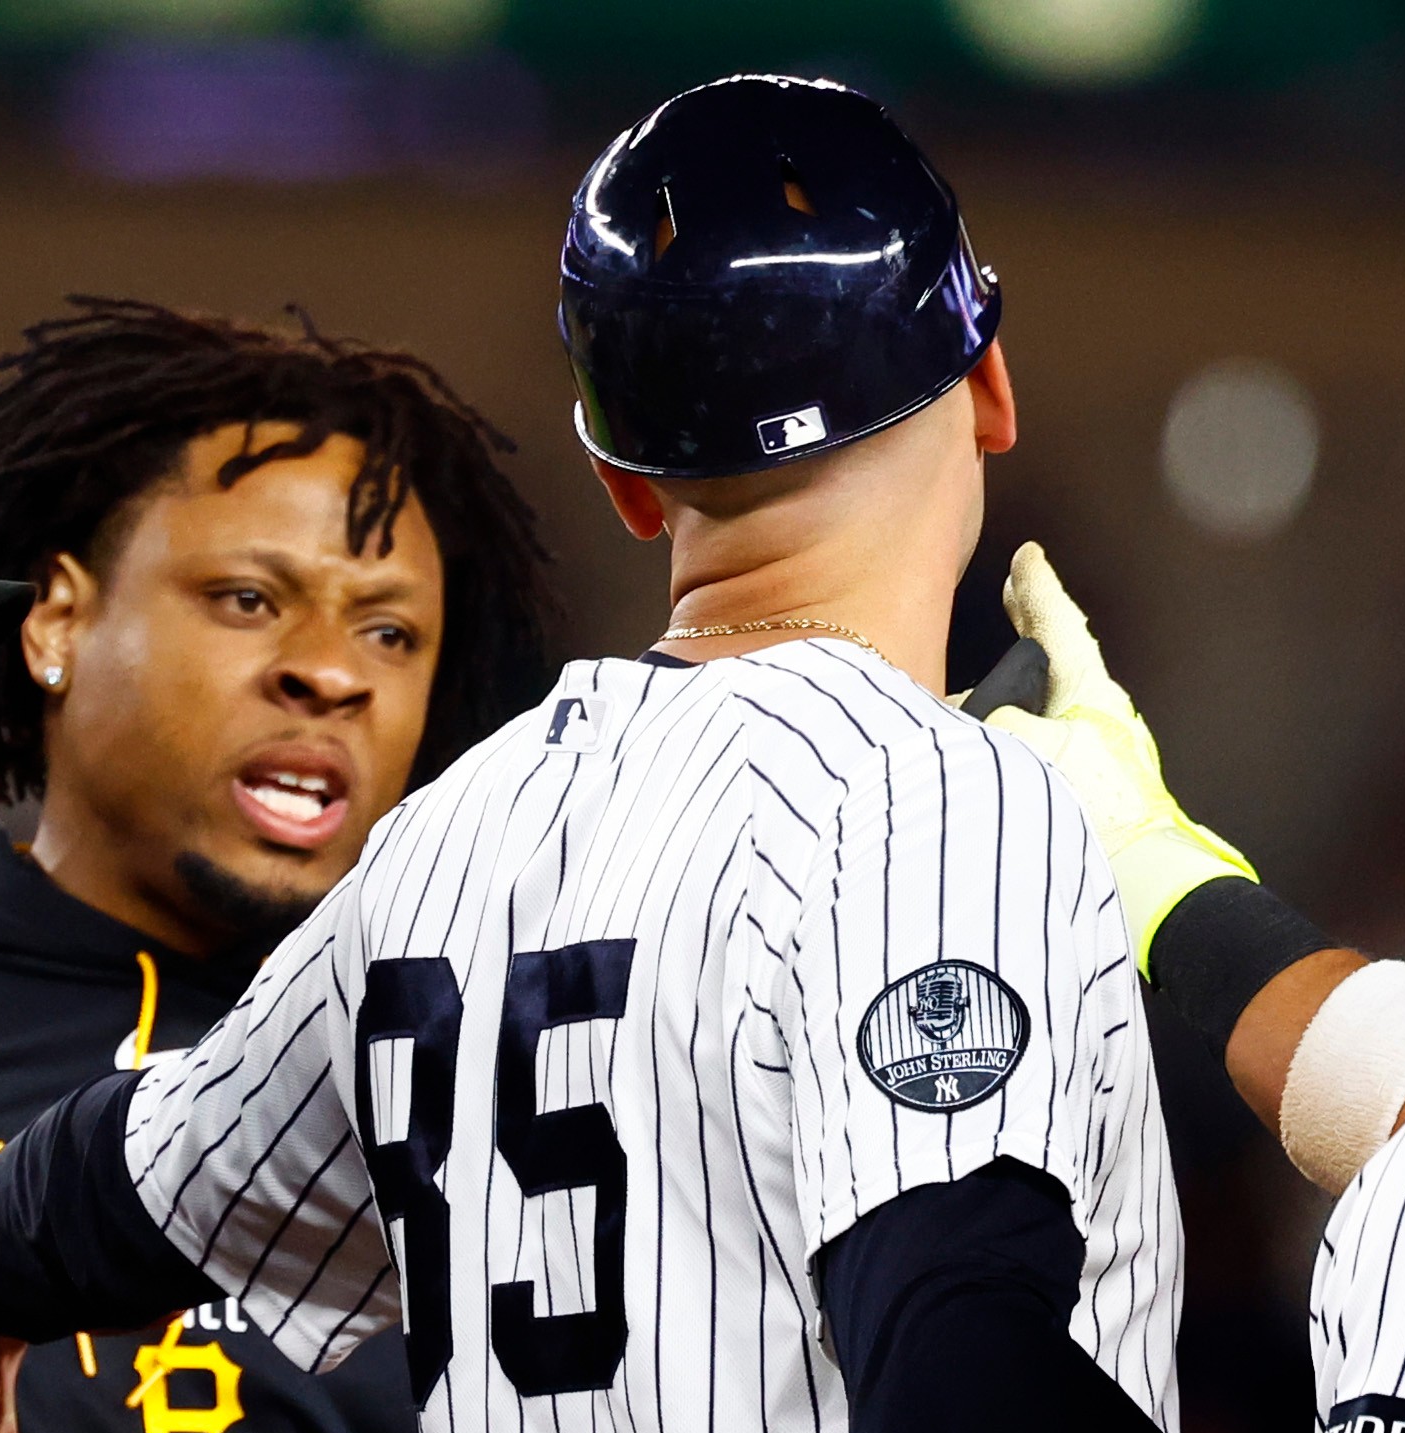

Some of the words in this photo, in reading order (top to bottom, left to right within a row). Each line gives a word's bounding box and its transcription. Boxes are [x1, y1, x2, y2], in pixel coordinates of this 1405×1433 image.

[885, 1058, 927, 1086] JOHN
[930, 1050, 1007, 1071] STERLING
[934, 1074, 961, 1103] NY
[355, 938, 637, 1412] 85
